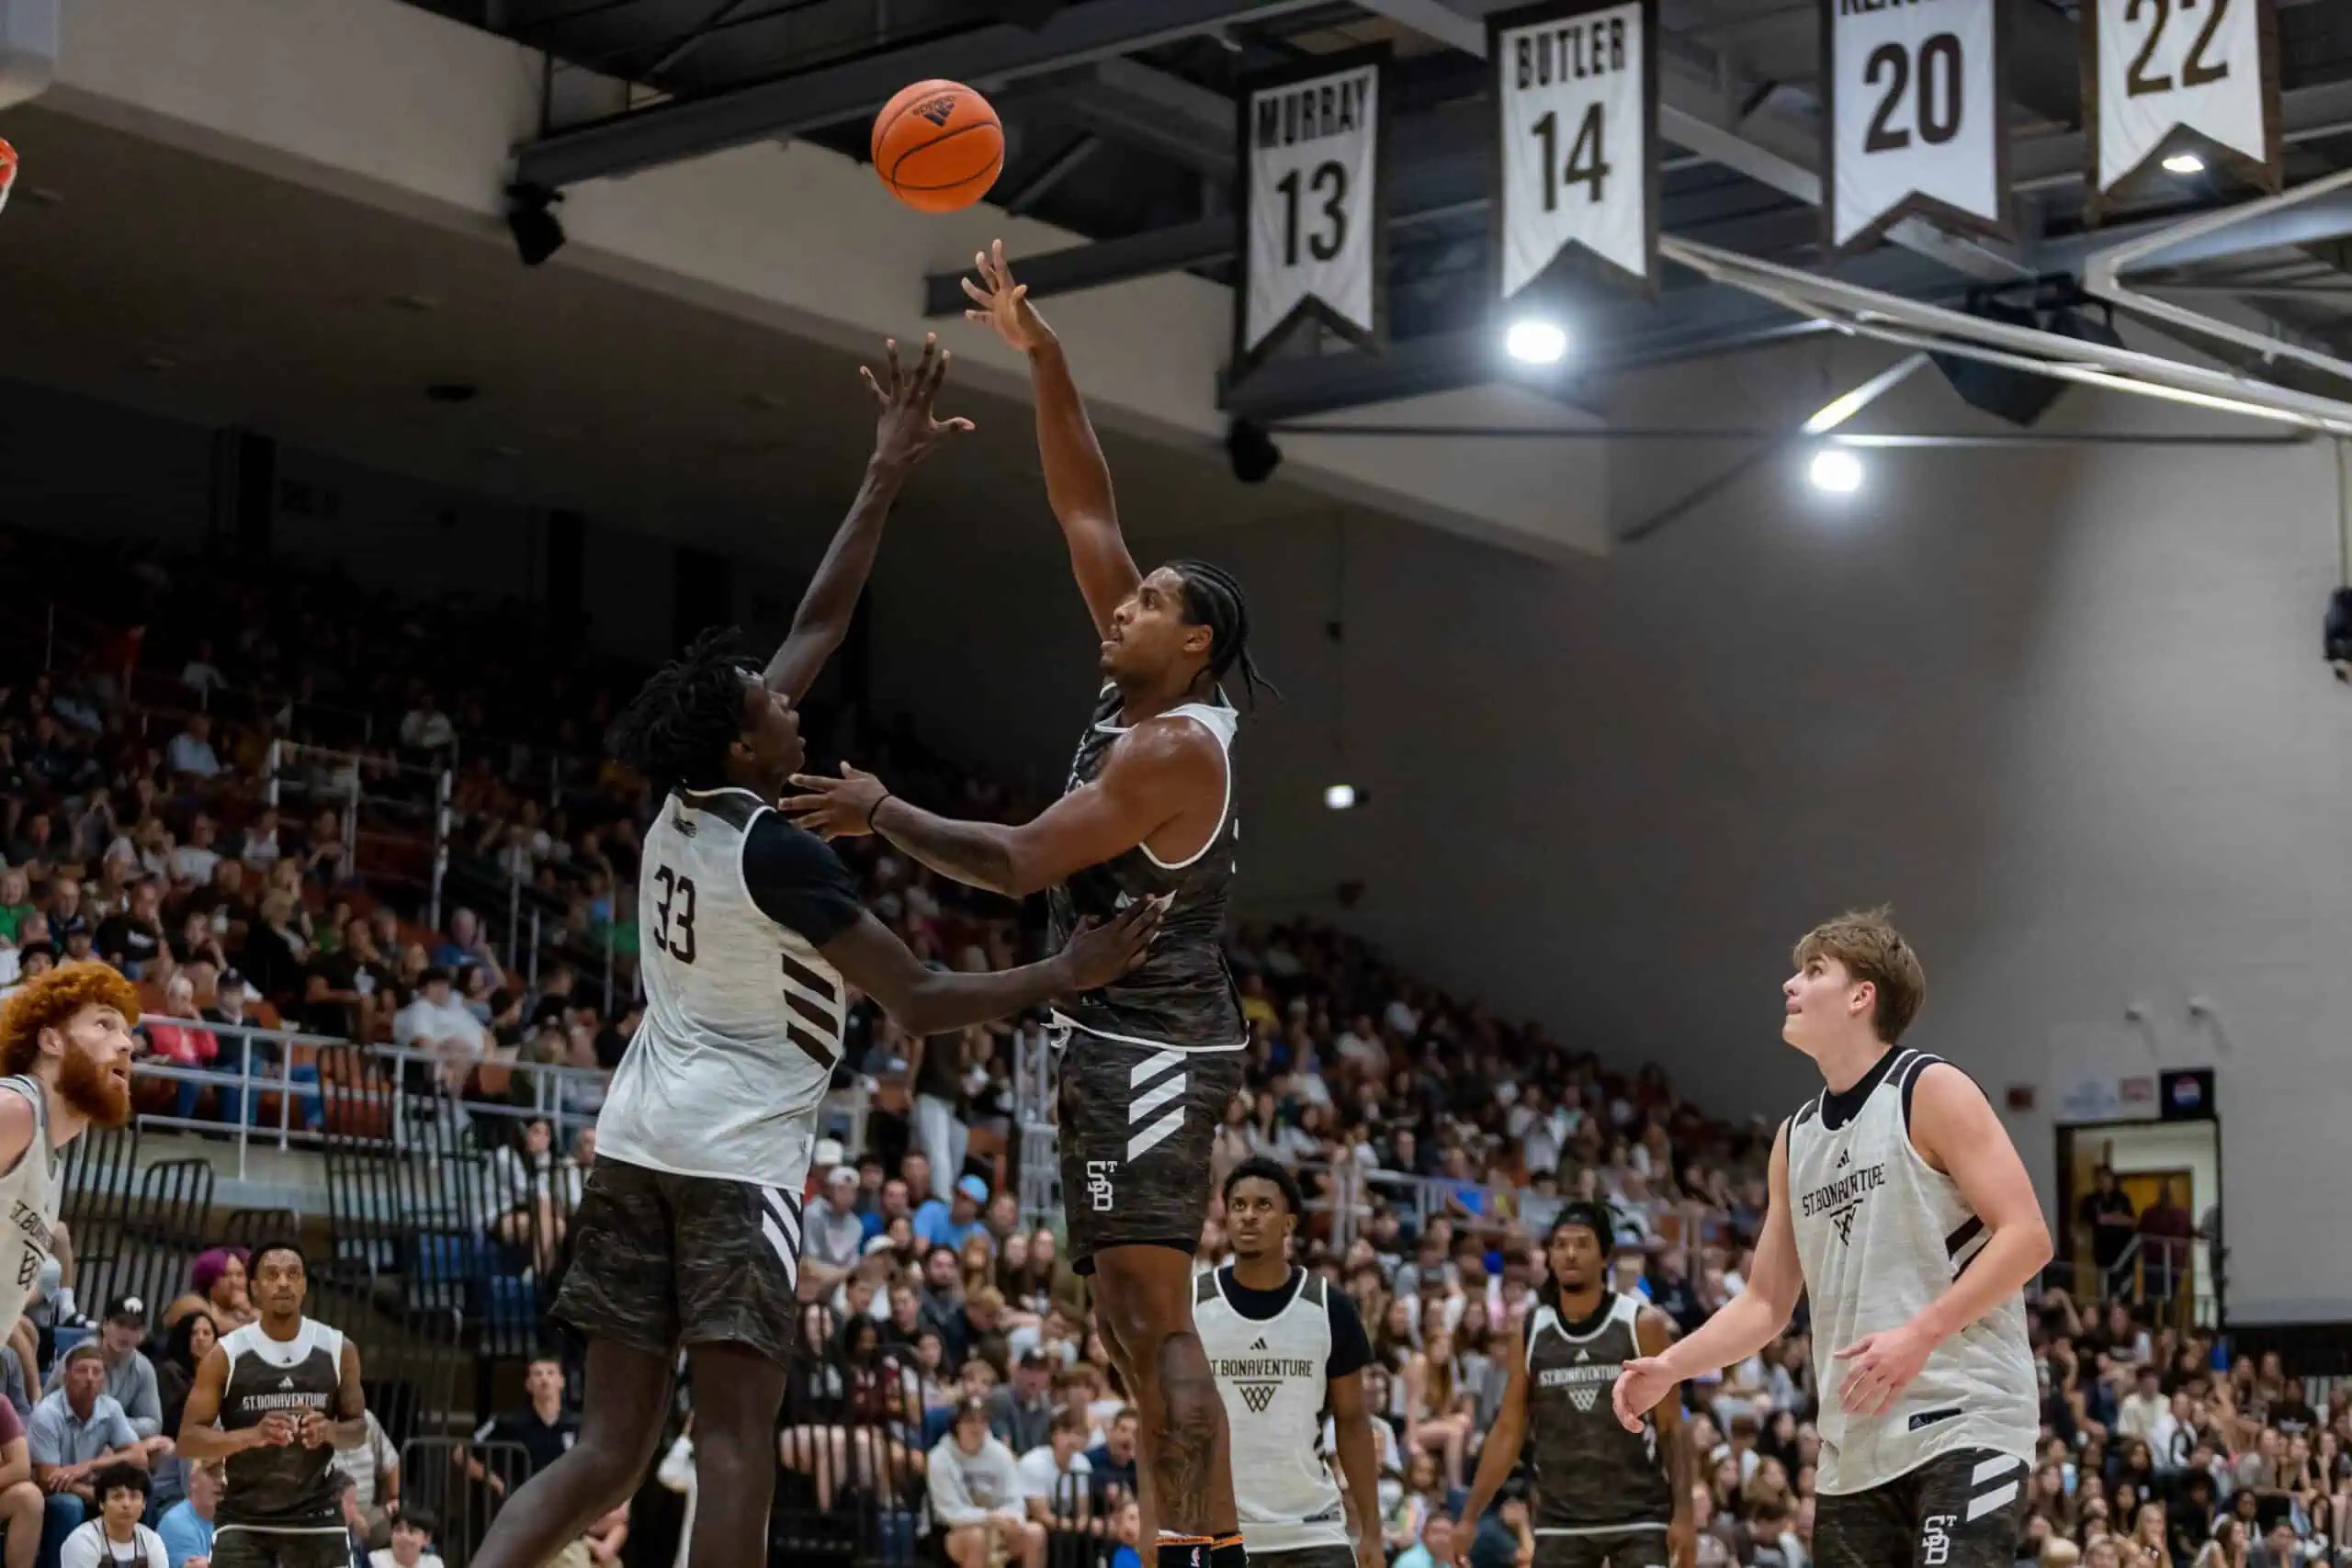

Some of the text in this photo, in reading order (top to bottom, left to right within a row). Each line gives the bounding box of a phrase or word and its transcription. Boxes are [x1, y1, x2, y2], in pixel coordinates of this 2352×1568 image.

[1516, 17, 1625, 90] BUTLER
[1864, 32, 1962, 153] 20
[2125, 0, 2228, 98] 22
[1258, 77, 1369, 150] MURRAY
[1532, 102, 1611, 212] 14
[1276, 161, 1347, 266] 13
[654, 863, 696, 964] 33
